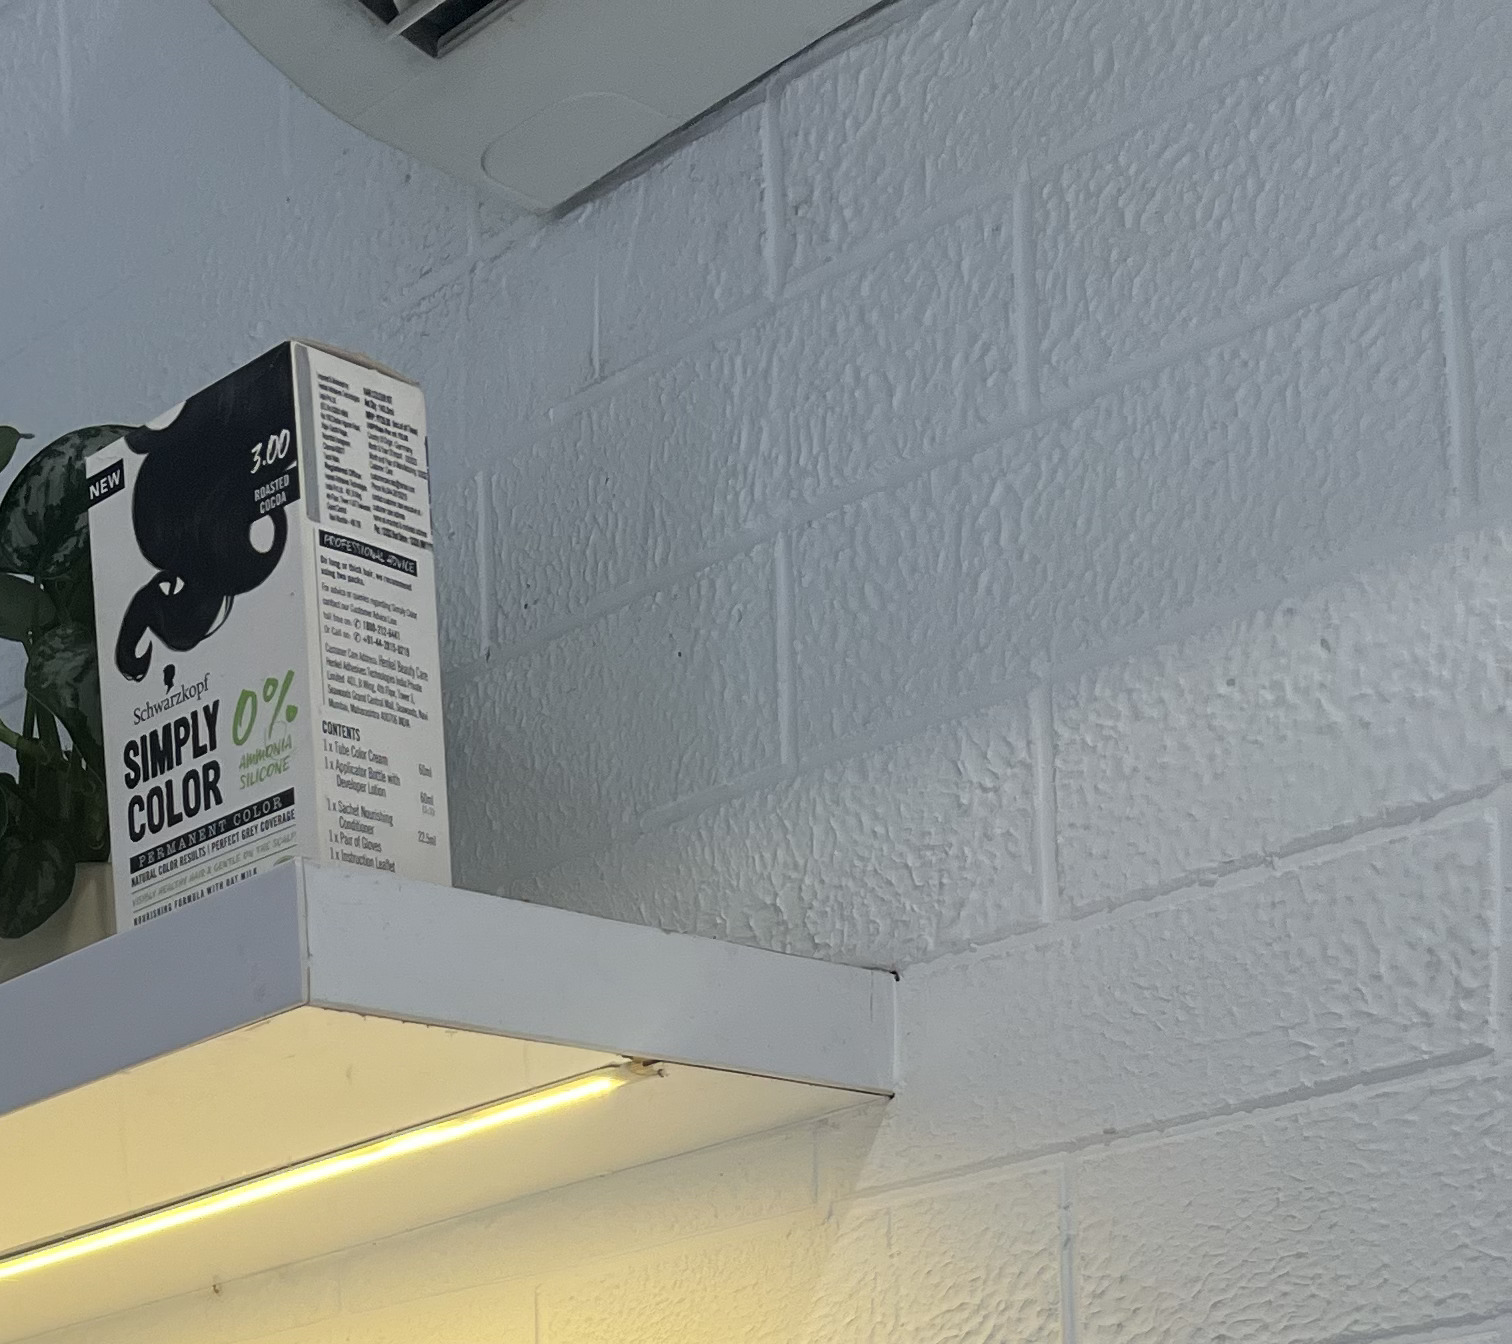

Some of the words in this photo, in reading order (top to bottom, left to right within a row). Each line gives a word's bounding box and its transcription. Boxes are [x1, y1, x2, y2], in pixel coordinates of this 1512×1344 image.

[250, 428, 290, 474] 3.00
[89, 468, 121, 500] NEW
[254, 474, 290, 502] ROASTED
[260, 491, 287, 514] COCOA
[323, 534, 384, 563] PROFESSIONAL
[133, 672, 210, 726] Schwarzkopf
[232, 669, 298, 746] 0%
[124, 699, 220, 789] SIMPLY
[322, 720, 361, 742] CONTENTS
[239, 734, 292, 769] AMMONIA
[334, 741, 350, 757] Tube
[351, 745, 367, 760] Color
[368, 749, 389, 766] Cream
[240, 755, 291, 790] SILICONE
[128, 760, 223, 842] COLOR
[131, 869, 157, 888] NATURAL
[158, 860, 178, 876] COLOR
[179, 848, 206, 866] RESULTS
[211, 831, 240, 852] PERFECT
[241, 825, 259, 841] GREY
[260, 809, 295, 833] COVERAGE
[139, 819, 226, 868] PERMANENT
[233, 796, 283, 826] COLOR
[134, 903, 172, 926] NOURISHING
[174, 889, 204, 908] FORMULA
[206, 882, 224, 896] WITH
